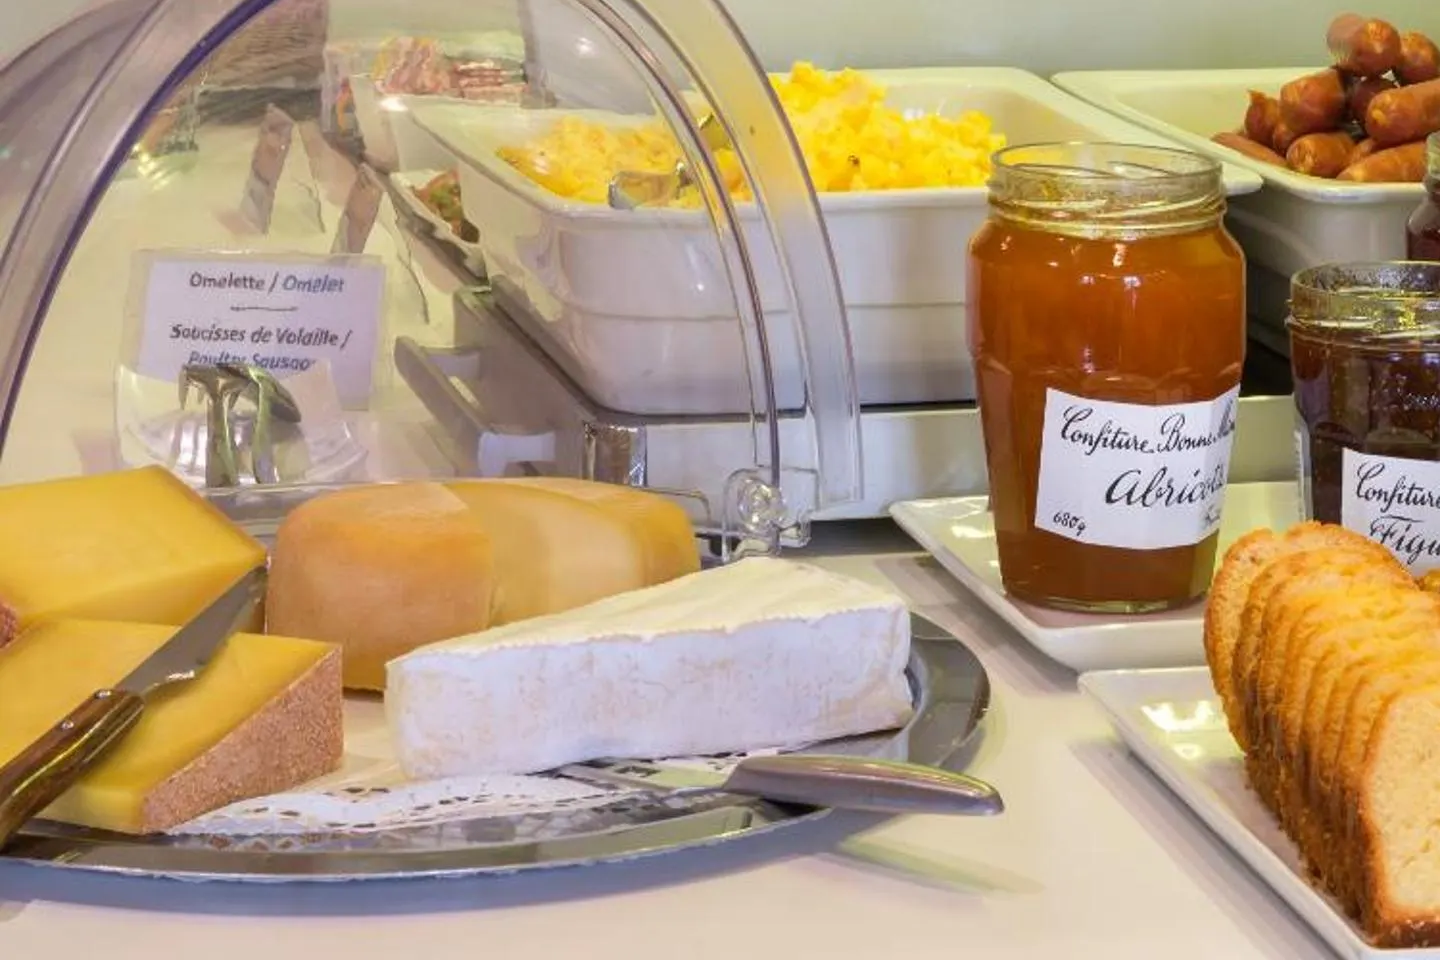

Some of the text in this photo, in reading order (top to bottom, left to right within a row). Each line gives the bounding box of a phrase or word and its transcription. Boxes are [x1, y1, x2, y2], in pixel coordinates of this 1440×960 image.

[189, 272, 264, 291] Omelette
[282, 275, 344, 293] Omelet
[169, 324, 246, 342] Saucisses
[250, 326, 273, 344] de
[275, 327, 339, 346] Volaille
[1060, 404, 1153, 456] Confiture
